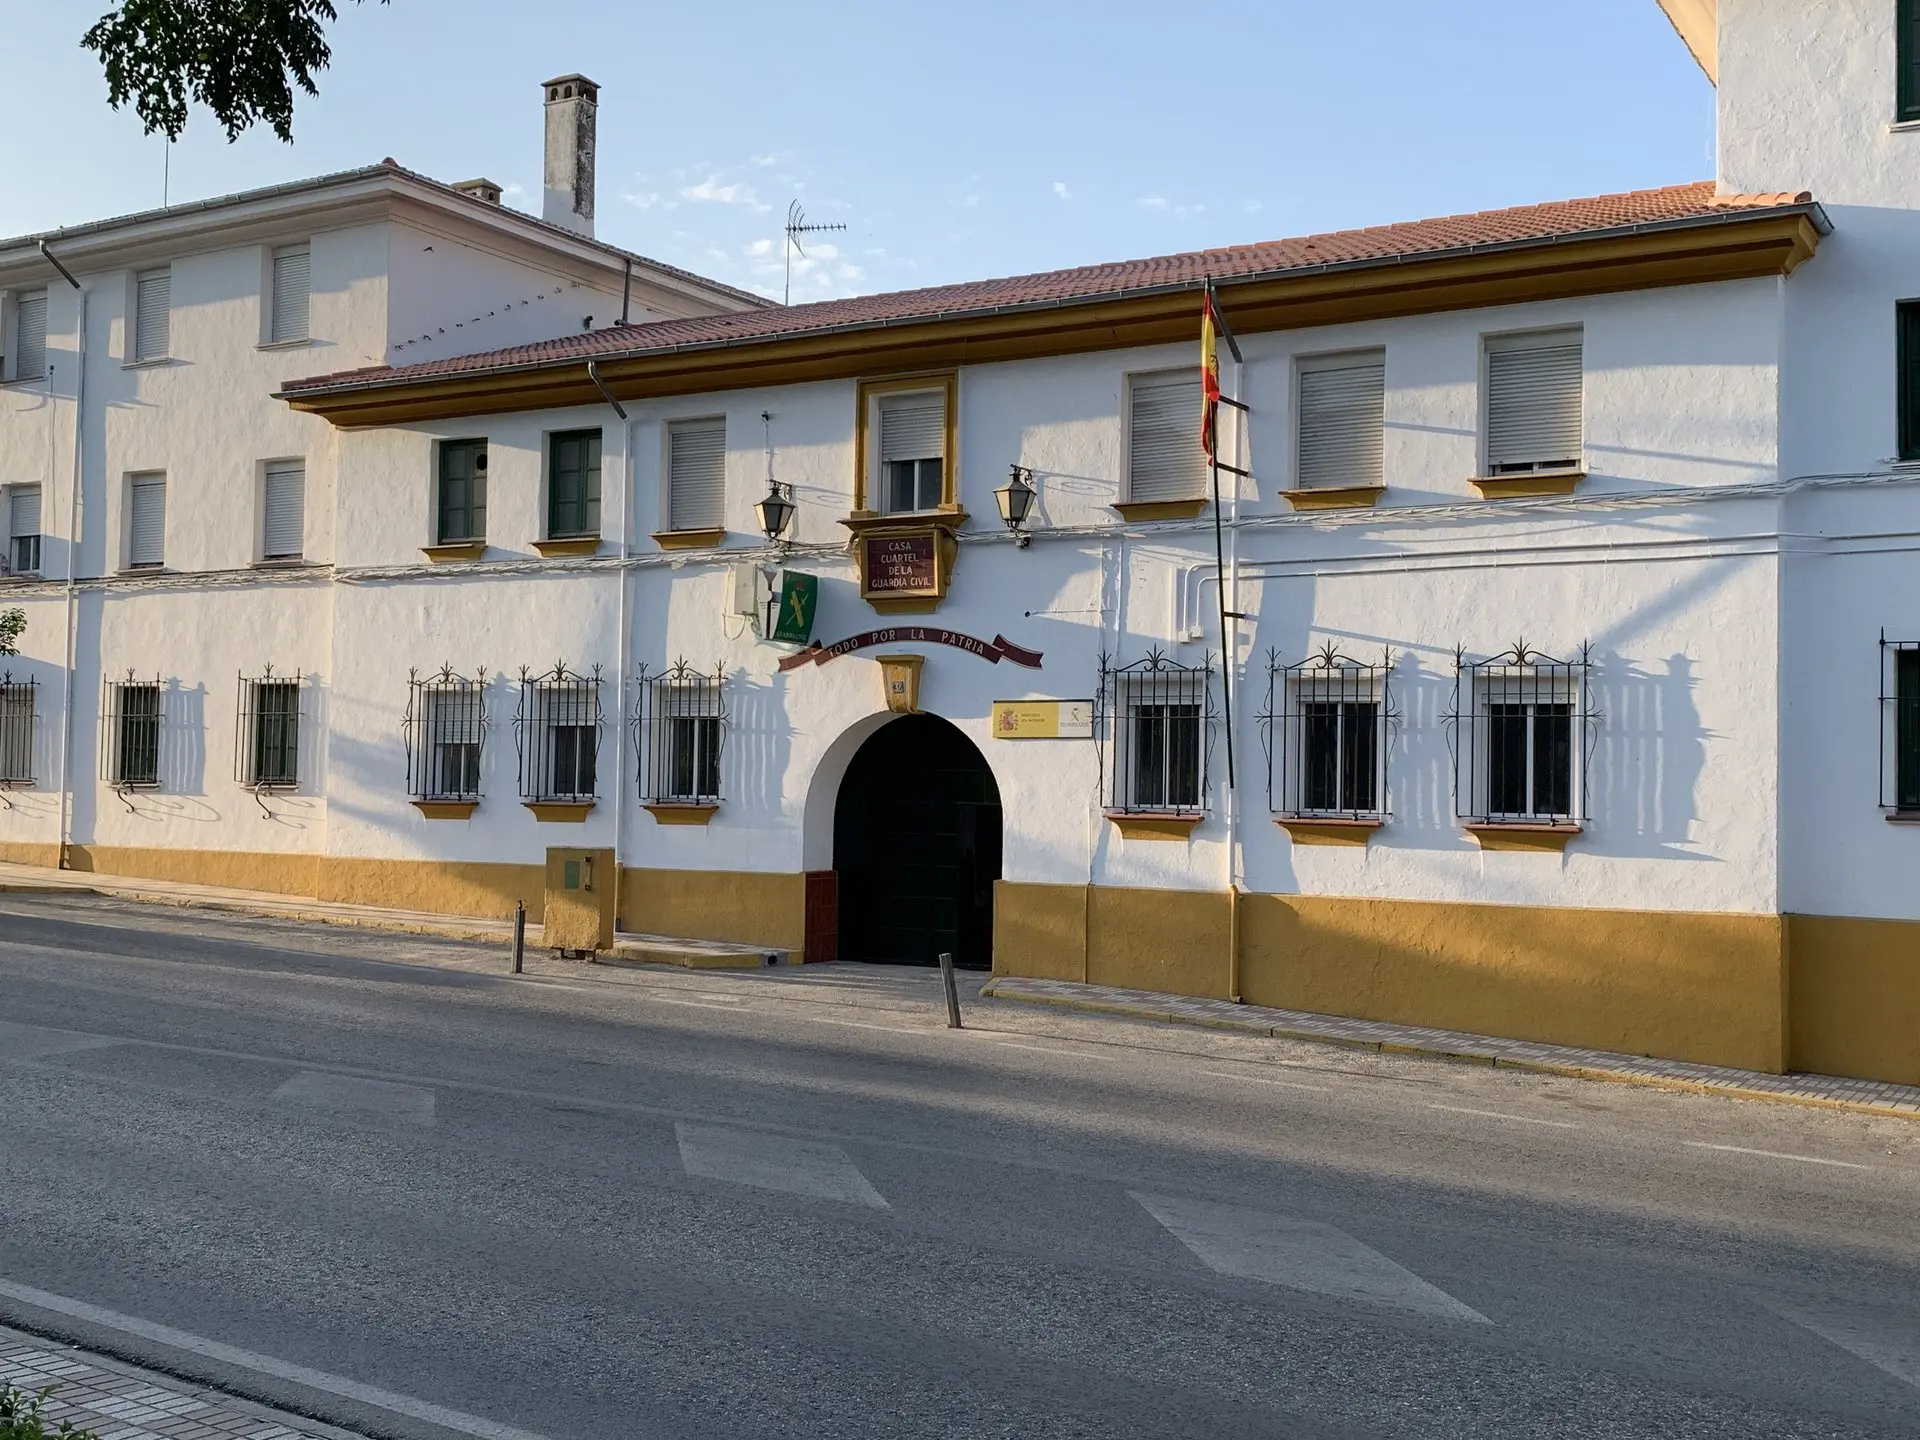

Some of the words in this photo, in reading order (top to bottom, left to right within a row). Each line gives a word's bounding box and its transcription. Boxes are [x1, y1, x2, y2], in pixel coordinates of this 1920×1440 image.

[888, 541, 912, 551] CASA
[880, 553, 919, 563] CUARTEL
[871, 578, 907, 588] GUARDIA
[910, 576, 932, 586] CIVIL
[829, 638, 859, 658] TODO
[871, 630, 896, 644] POR
[910, 628, 925, 640] LA
[941, 631, 984, 655] PATRIA
